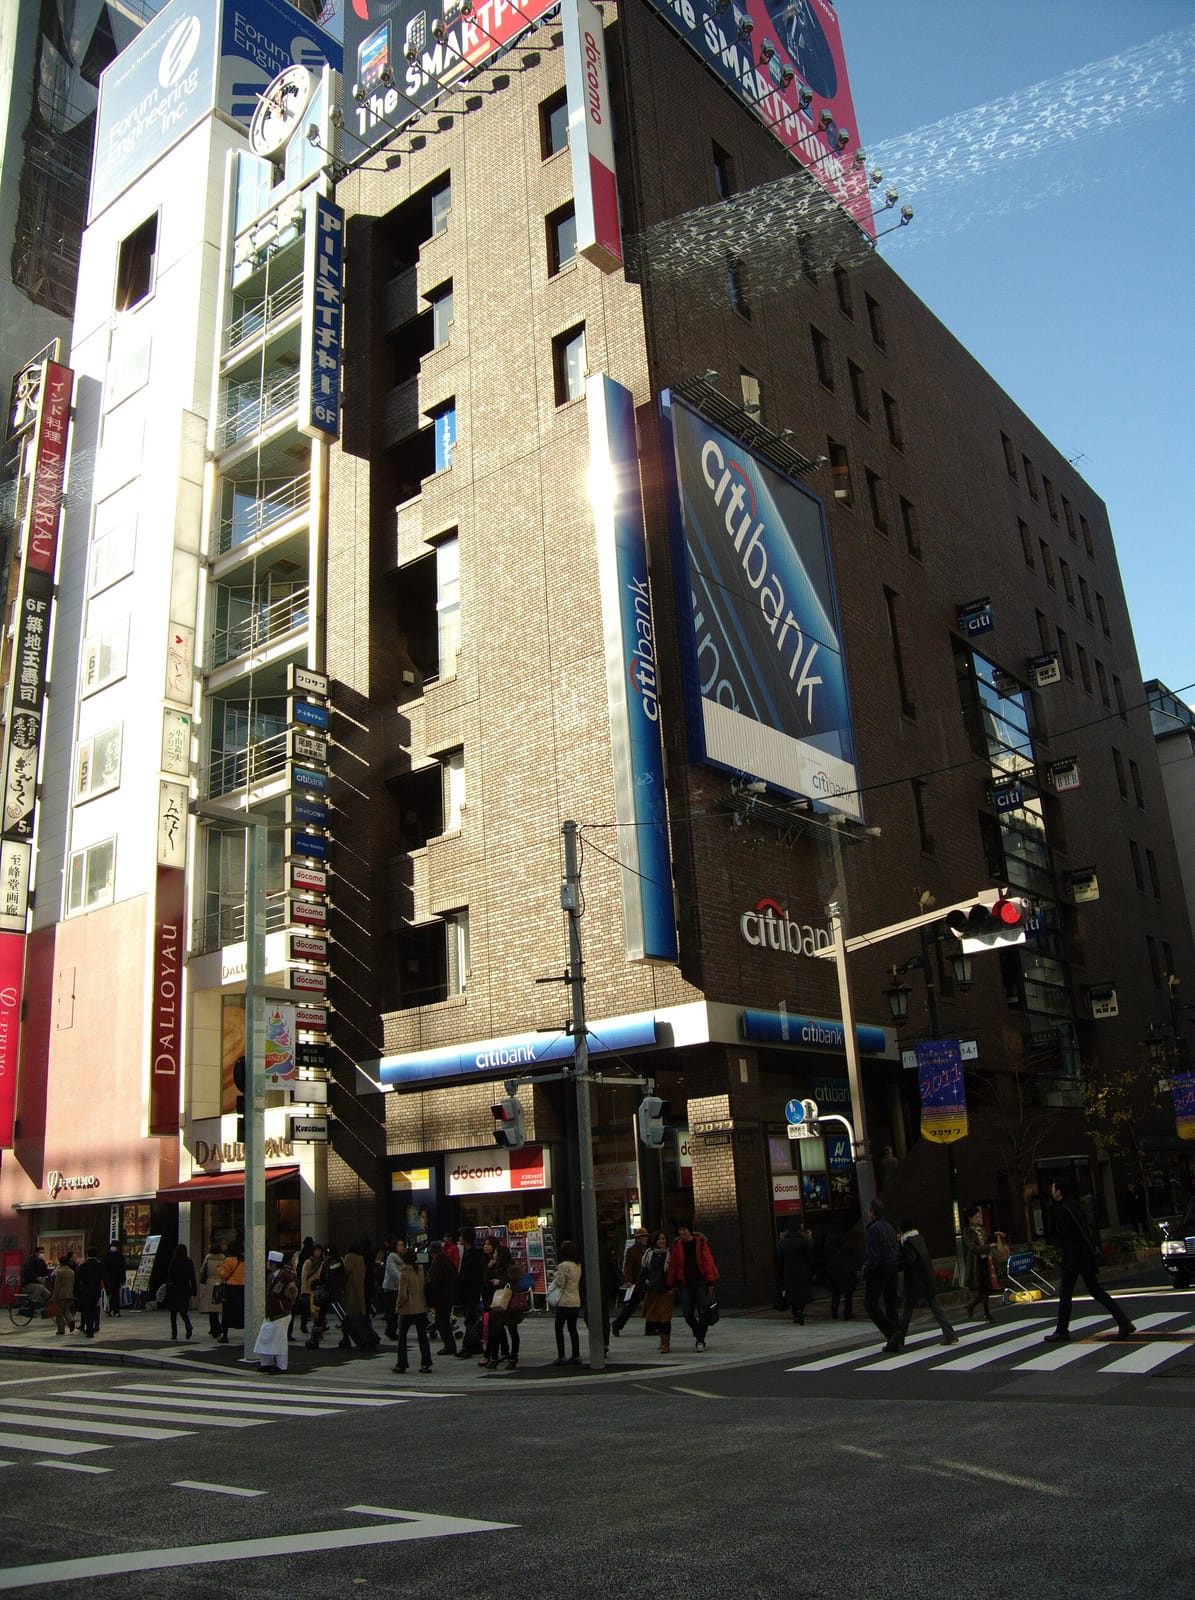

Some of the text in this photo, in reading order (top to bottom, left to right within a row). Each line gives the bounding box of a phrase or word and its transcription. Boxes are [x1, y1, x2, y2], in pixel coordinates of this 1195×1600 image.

[234, 12, 291, 64] Forum
[234, 29, 282, 73] Engin
[584, 31, 602, 125] docomo
[107, 66, 200, 163] Engineering
[110, 87, 159, 146] Forum
[161, 101, 188, 134] Inc.
[356, 86, 398, 136] The
[45, 382, 65, 445] インド料理
[315, 406, 337, 425] 6F
[32, 448, 61, 557] NATARAJ
[701, 438, 824, 725] citibank
[25, 598, 47, 614] 6F
[968, 612, 990, 630] citi
[628, 577, 659, 724] citibank
[298, 675, 325, 689] クロサワ
[296, 774, 324, 787] citibank
[813, 774, 853, 803] citibank
[997, 787, 1020, 806] citi
[18, 820, 32, 834] 5F
[296, 871, 324, 883] docomo
[296, 905, 324, 917] docomo
[296, 939, 324, 952] docomo
[296, 974, 324, 987] docomo
[154, 923, 178, 1076] DALLOYAU
[296, 1009, 324, 1022] docomo
[801, 1024, 843, 1047] citibank
[475, 1043, 536, 1069] citibank
[919, 1063, 959, 1097] 2011
[814, 1083, 850, 1104] citiban
[696, 1119, 734, 1132] クロサワ
[196, 1136, 295, 1165] DALLAU
[452, 1164, 503, 1180] docomo
[774, 1184, 799, 1193] docomo
